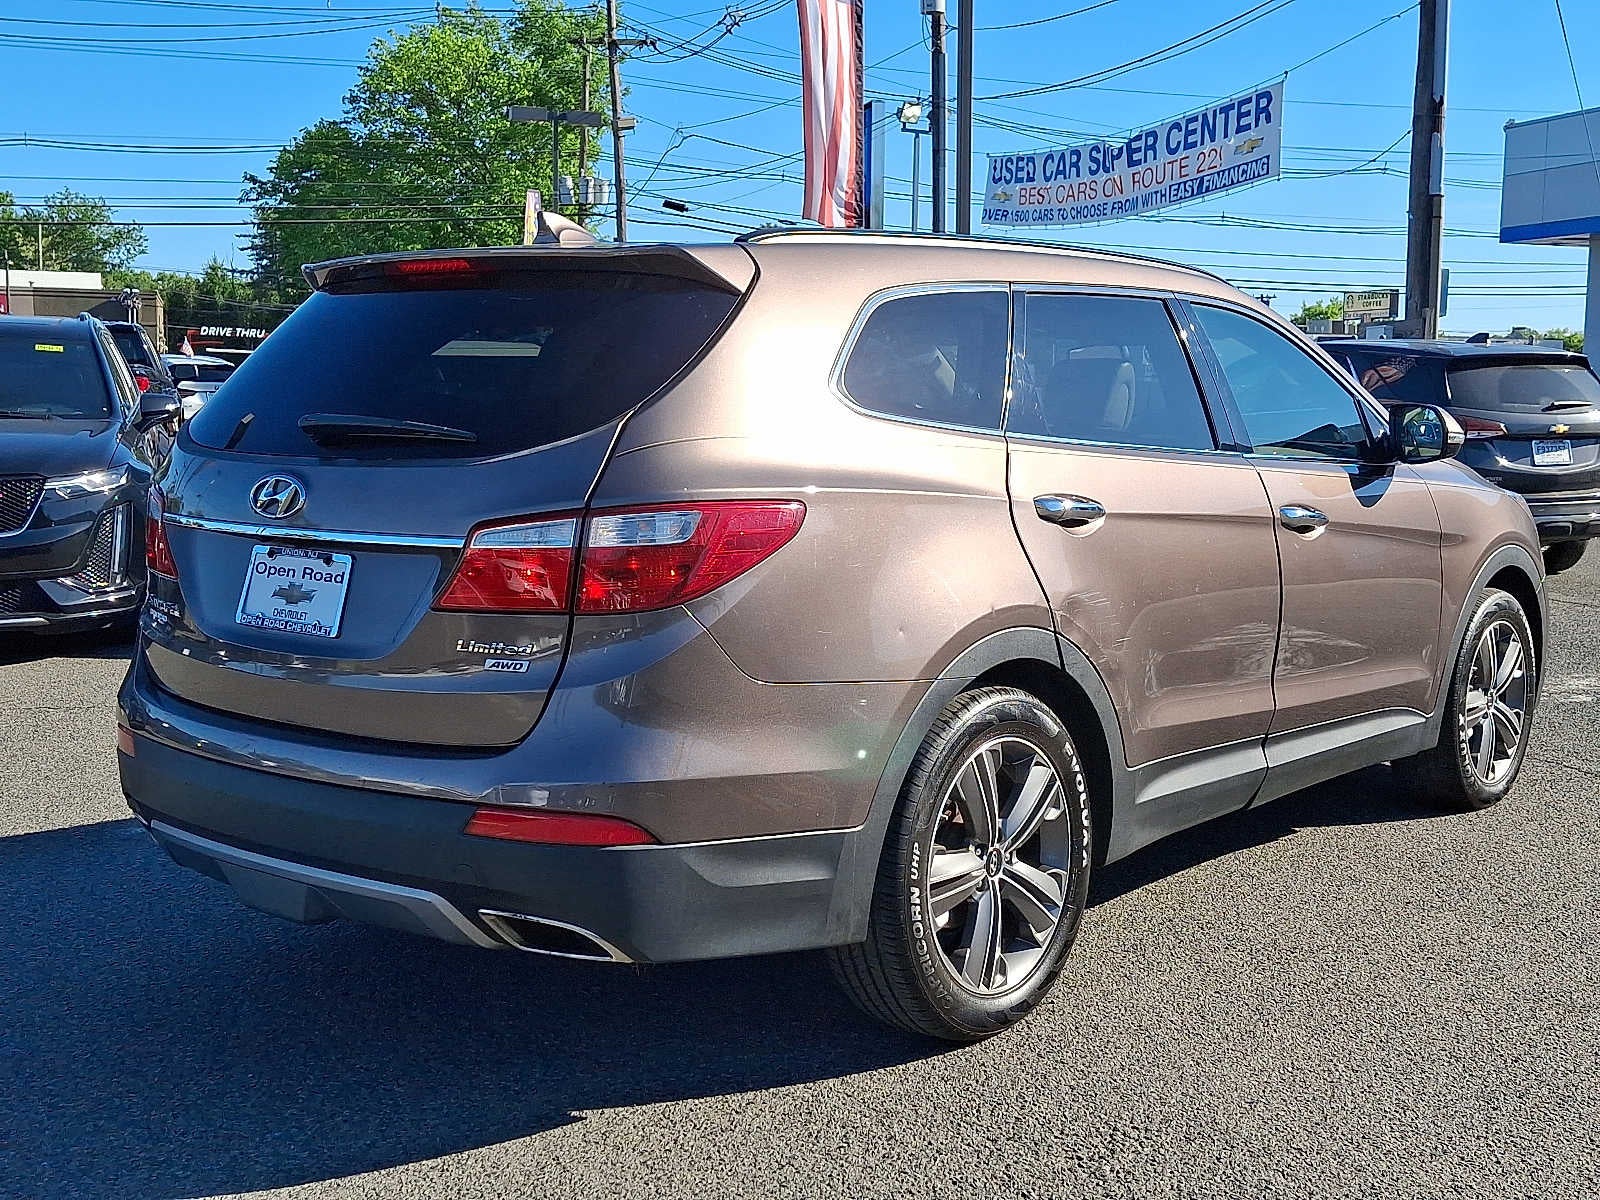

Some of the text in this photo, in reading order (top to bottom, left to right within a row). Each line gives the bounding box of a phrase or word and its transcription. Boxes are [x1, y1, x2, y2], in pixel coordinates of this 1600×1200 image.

[991, 90, 1273, 185] USED CAR SUPER CENTER
[1019, 145, 1223, 206] BEST CARS ON ROUTE 22!
[982, 157, 1269, 223] OVER 1500 CARS TO CHOOSE FROM WITH EASY FINANCING
[200, 325, 266, 339] DRIVE THRU
[255, 561, 346, 585] Open Road
[240, 614, 332, 636] OPEN ROAD CHEVROLET
[272, 607, 309, 621] CHEVROLET
[456, 639, 535, 656] Limited
[488, 661, 524, 671] AWD
[909, 841, 922, 881] UHP
